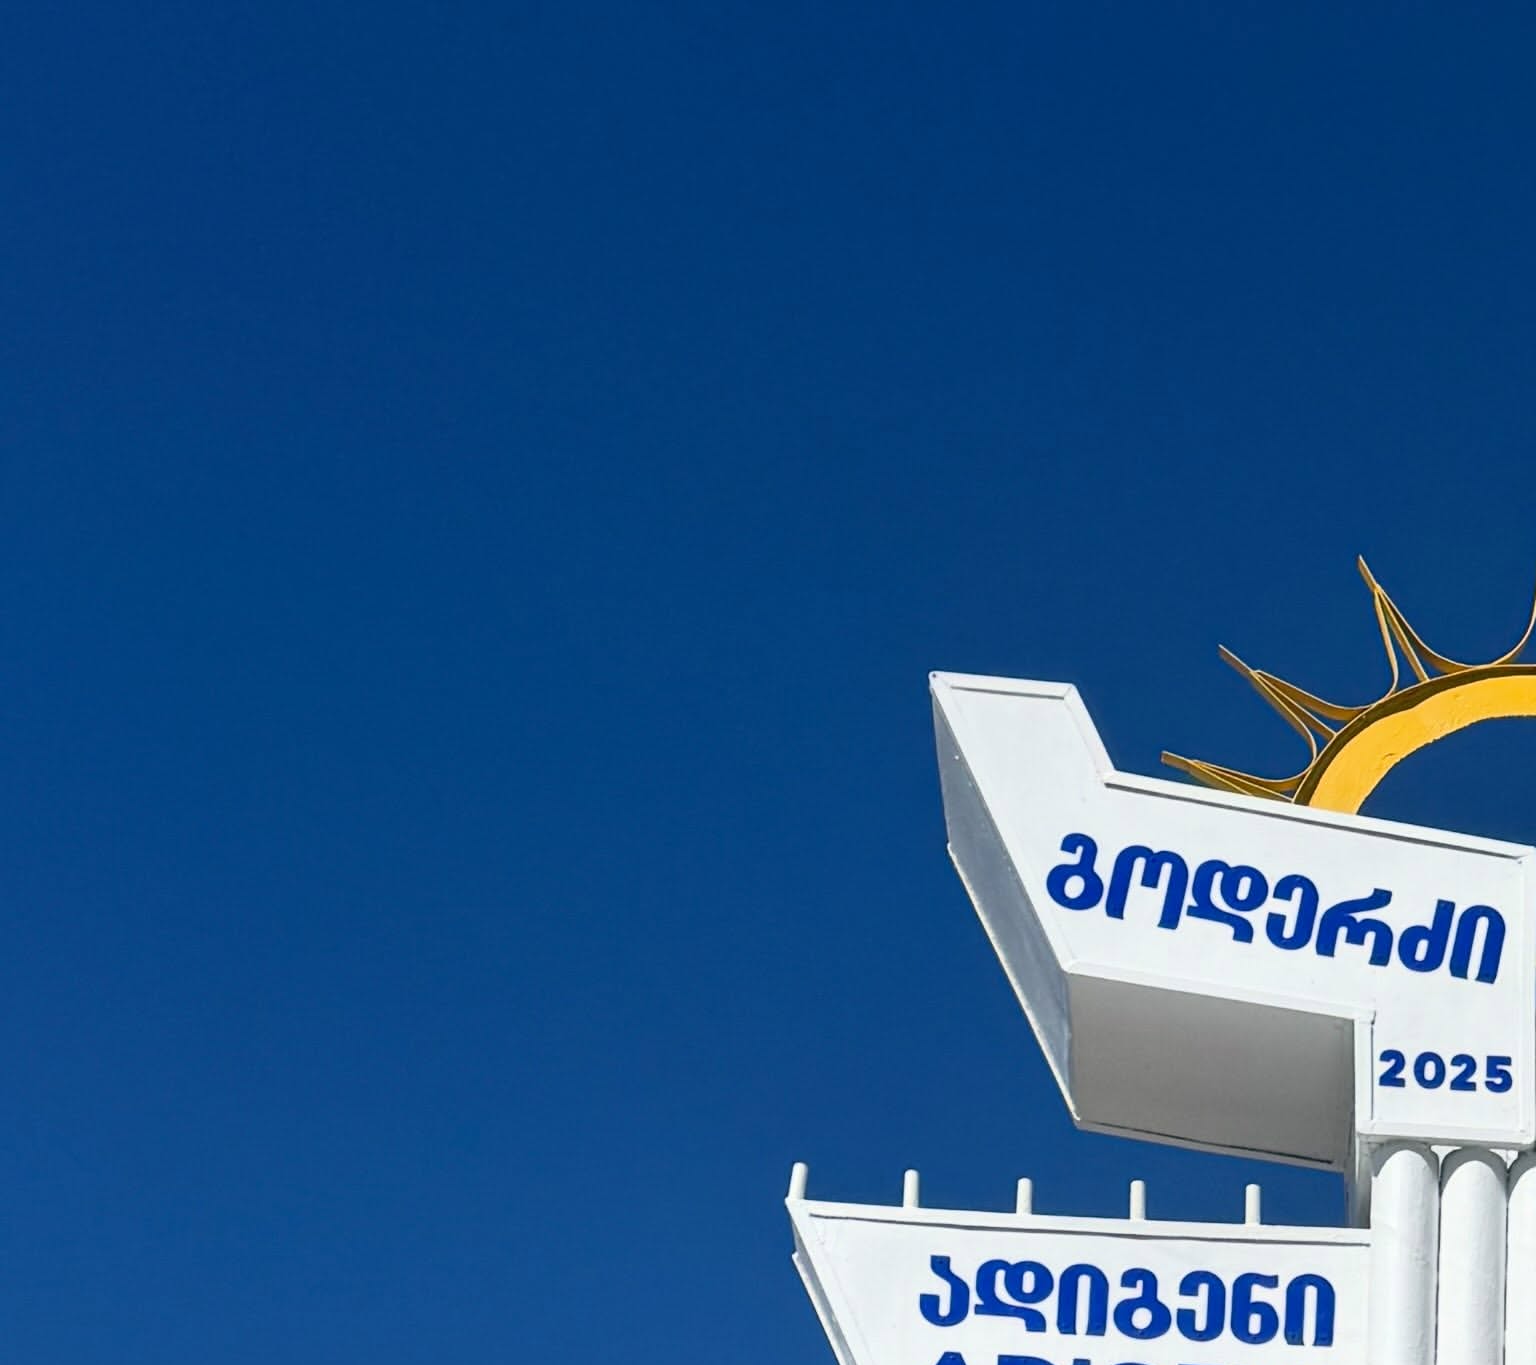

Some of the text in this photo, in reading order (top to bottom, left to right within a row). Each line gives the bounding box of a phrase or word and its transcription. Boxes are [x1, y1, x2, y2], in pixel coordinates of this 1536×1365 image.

[1046, 833, 1506, 983] გოდერძი
[1379, 1049, 1512, 1093] 2025
[919, 1255, 1335, 1346] ადიგენი
